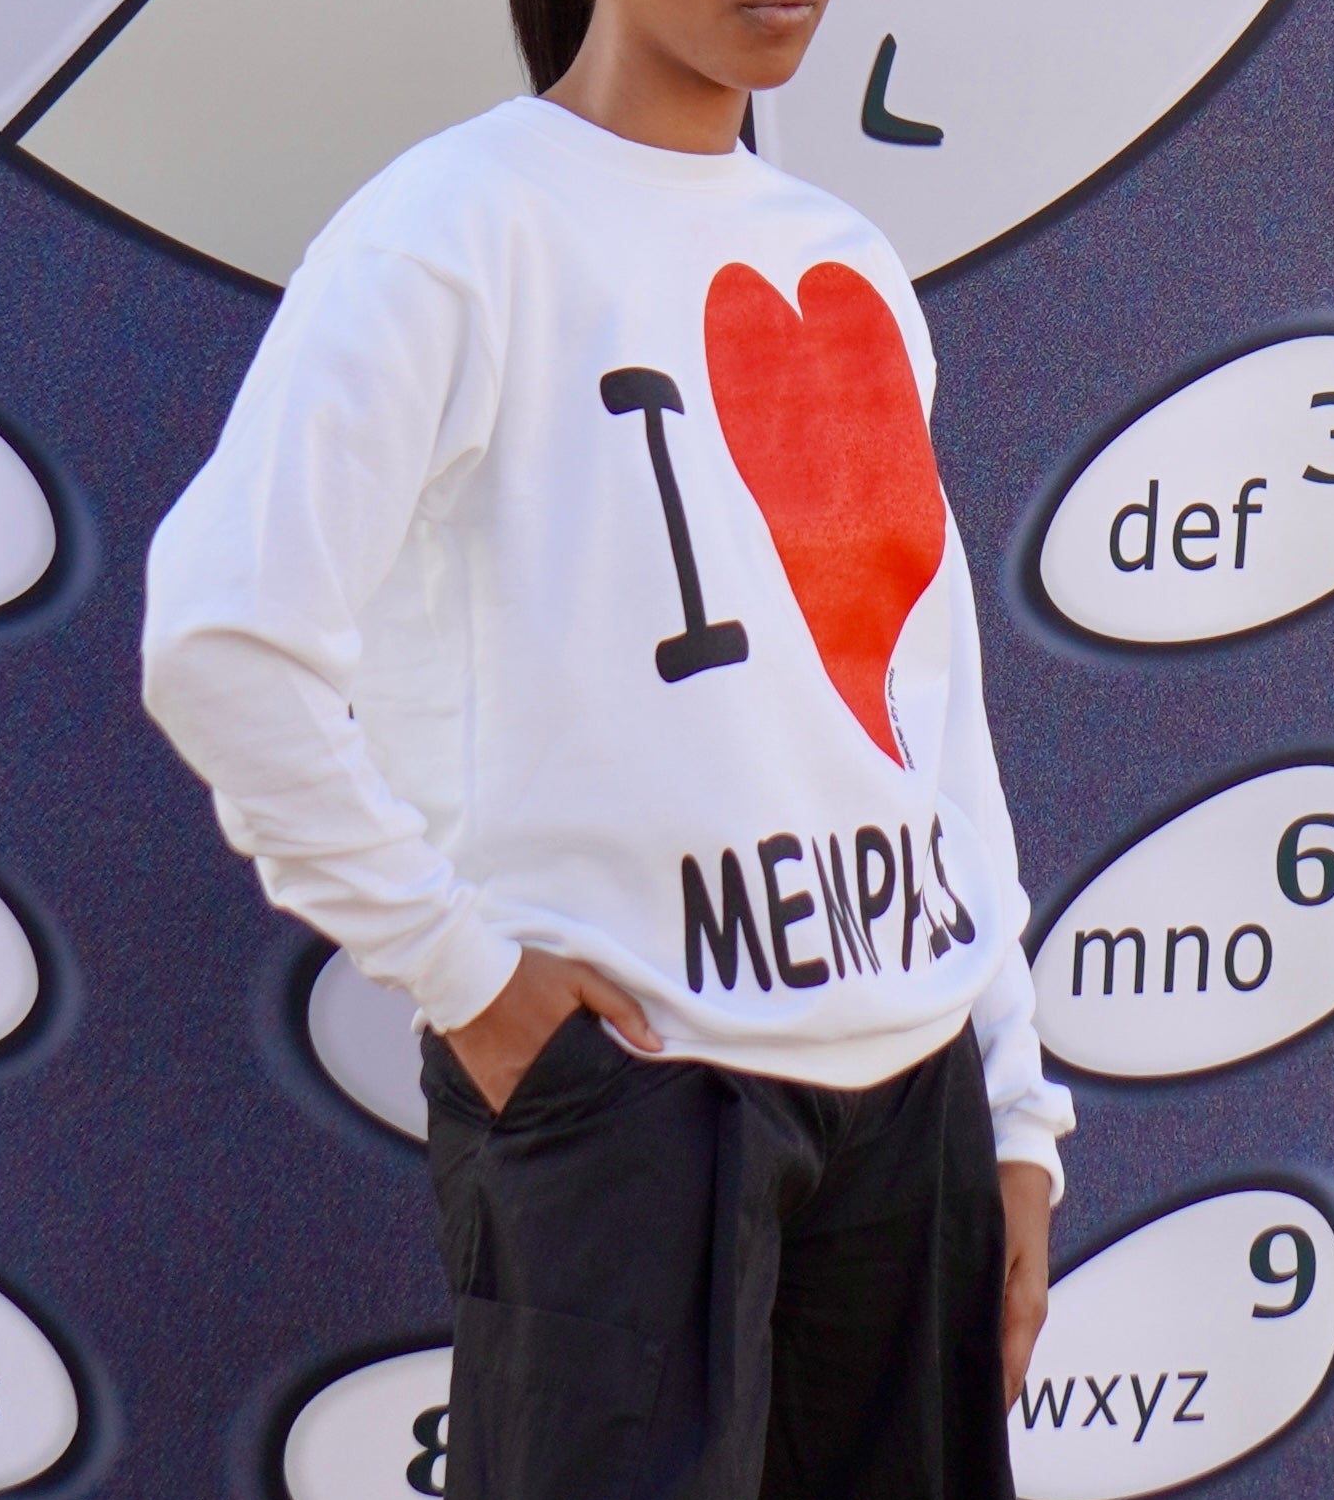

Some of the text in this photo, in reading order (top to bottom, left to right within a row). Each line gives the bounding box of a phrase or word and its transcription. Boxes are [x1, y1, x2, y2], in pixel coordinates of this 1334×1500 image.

[599, 366, 749, 684] I
[1109, 477, 1267, 573] def
[1071, 923, 1273, 997] mno
[1248, 1225, 1317, 1319] 9
[1020, 1370, 1209, 1443] wxyz
